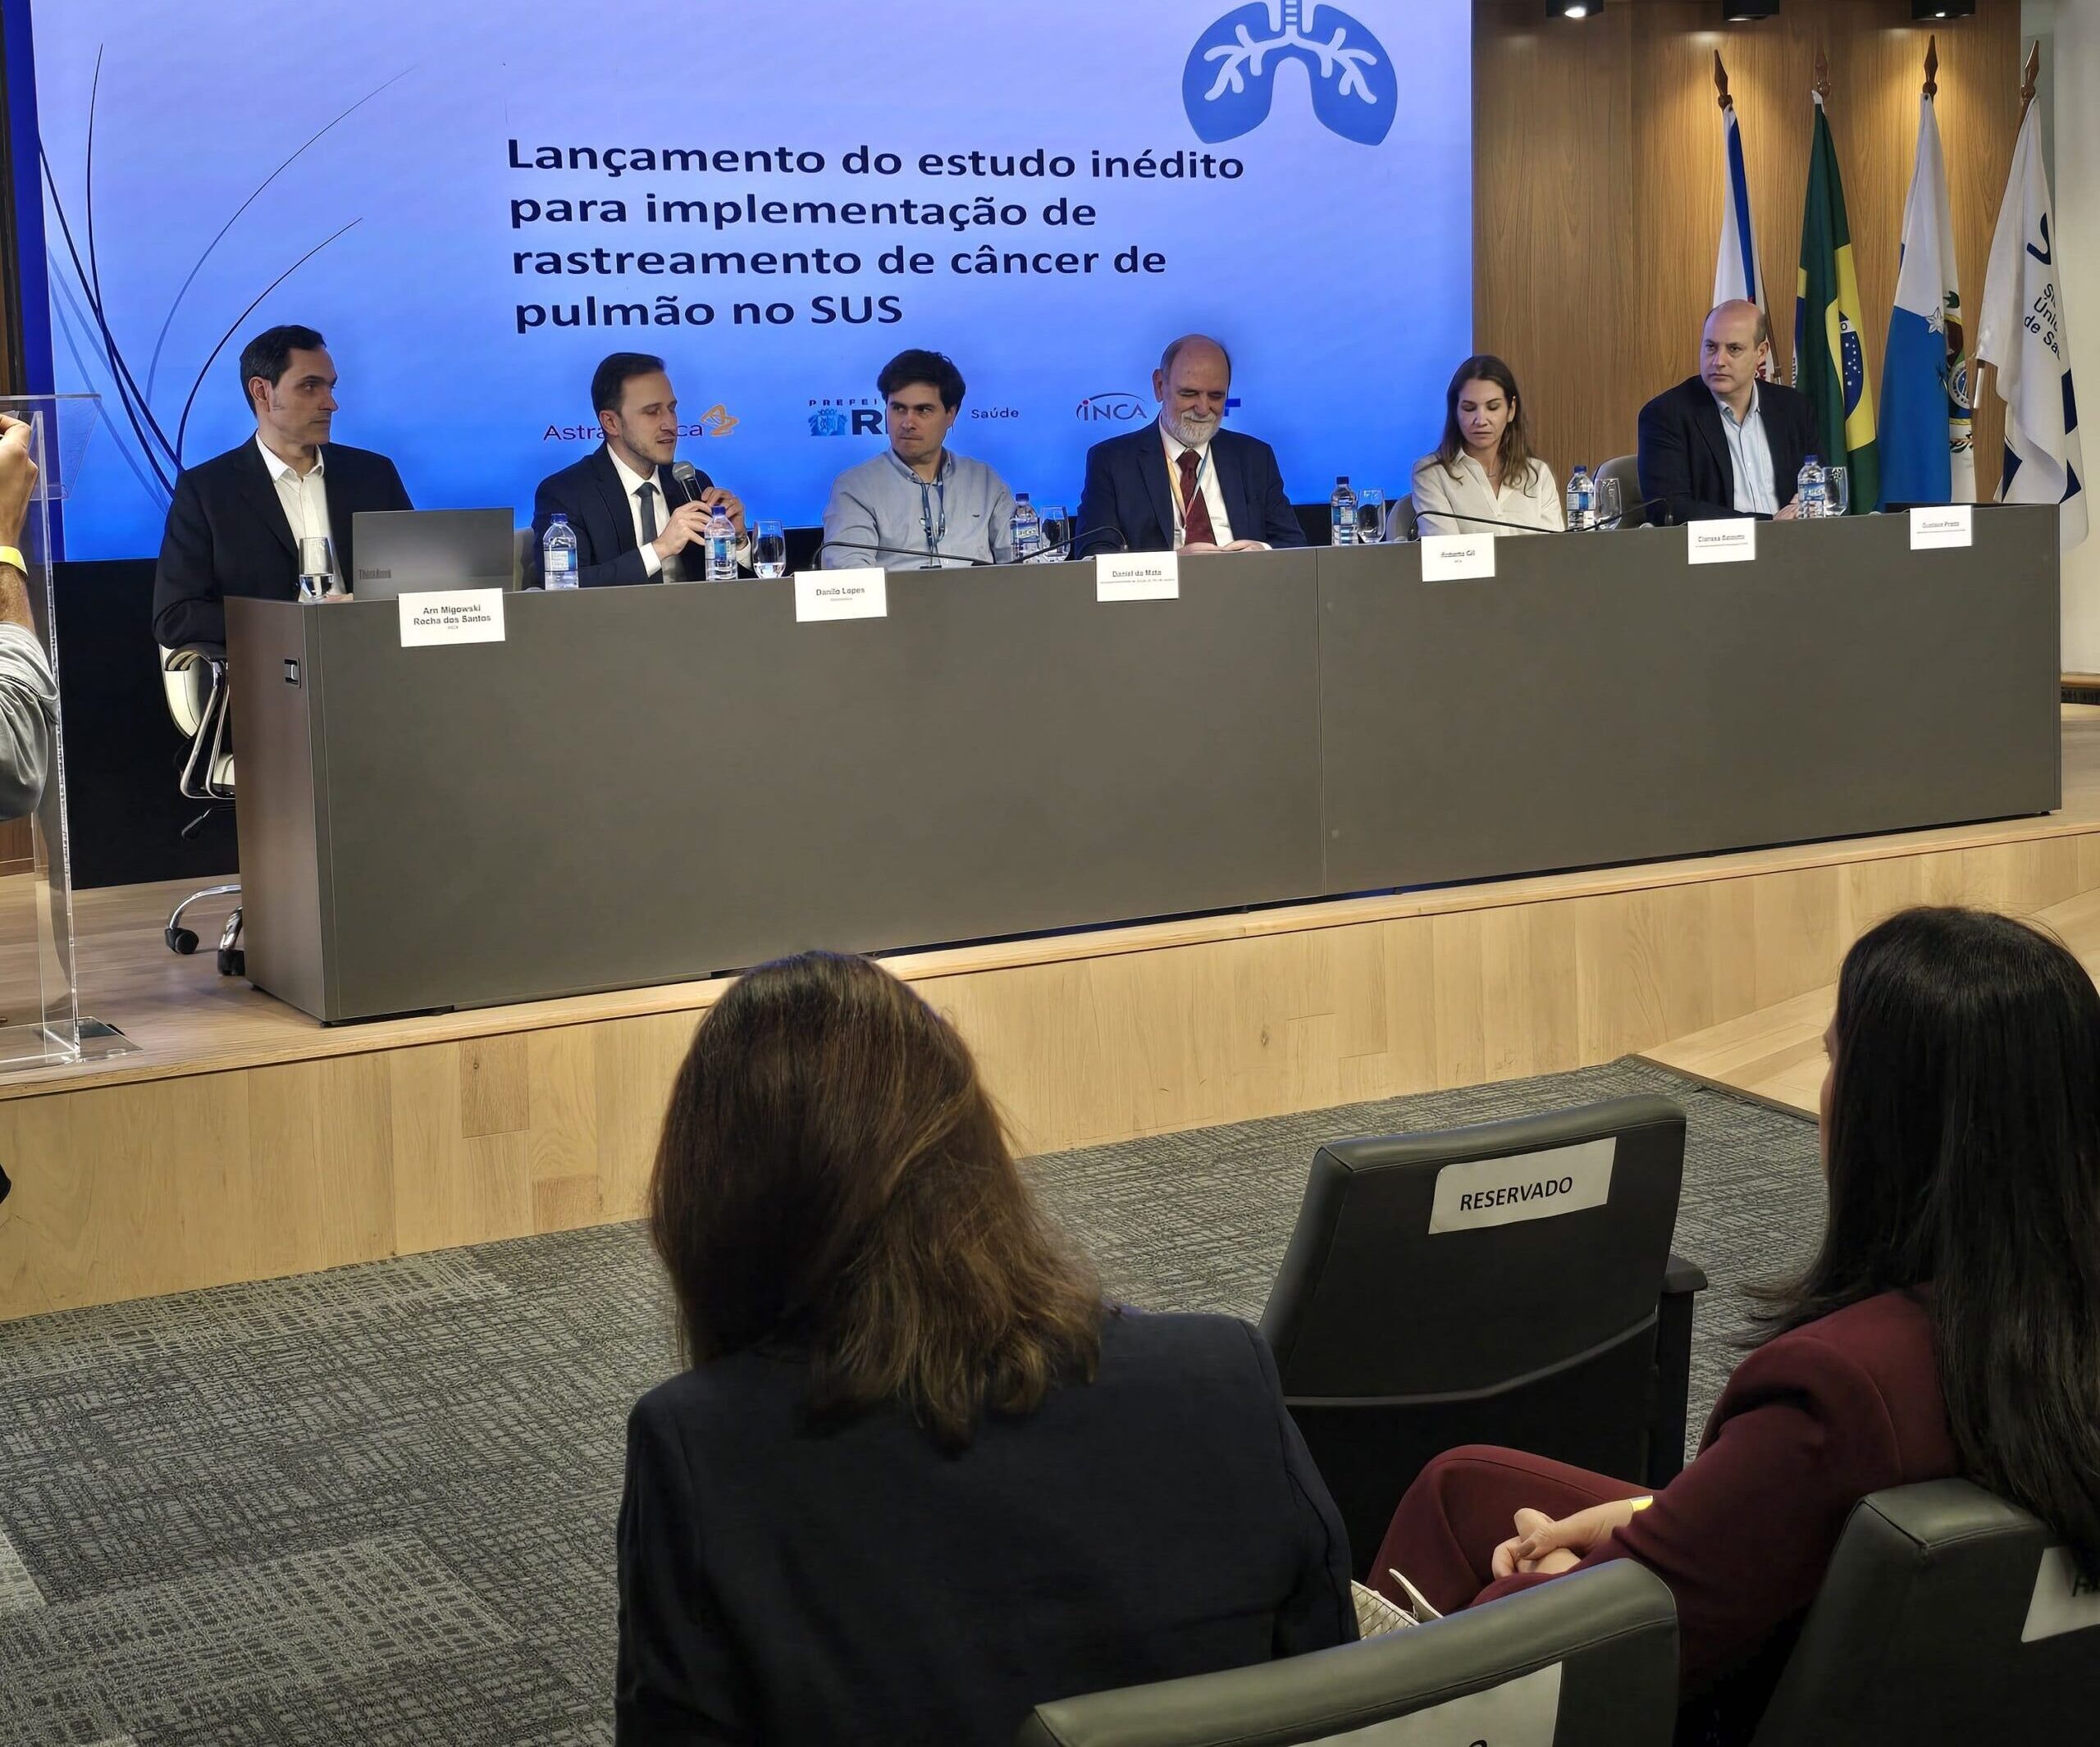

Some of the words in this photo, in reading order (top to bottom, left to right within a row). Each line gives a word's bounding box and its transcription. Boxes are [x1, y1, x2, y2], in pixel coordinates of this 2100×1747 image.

[509, 139, 824, 177] Lançamento
[842, 145, 902, 174] do
[919, 149, 1075, 176] estudo
[1093, 149, 1243, 178] inédito
[511, 199, 626, 228] para
[647, 194, 1026, 231] implementação
[1043, 198, 1095, 225] de
[514, 249, 861, 274] rastreamento
[879, 246, 934, 273] de
[952, 245, 1098, 273] câncer
[1114, 246, 1165, 273] de
[517, 296, 714, 332] pulmão
[734, 303, 794, 325] no
[812, 296, 902, 323] SUS
[2025, 316, 2041, 334] de
[809, 398, 878, 406] PREFEI
[971, 407, 1019, 418] Saúde
[413, 617, 441, 625] Rocha
[441, 604, 481, 615] Migowski
[1460, 1177, 1573, 1211] RESERVADO
